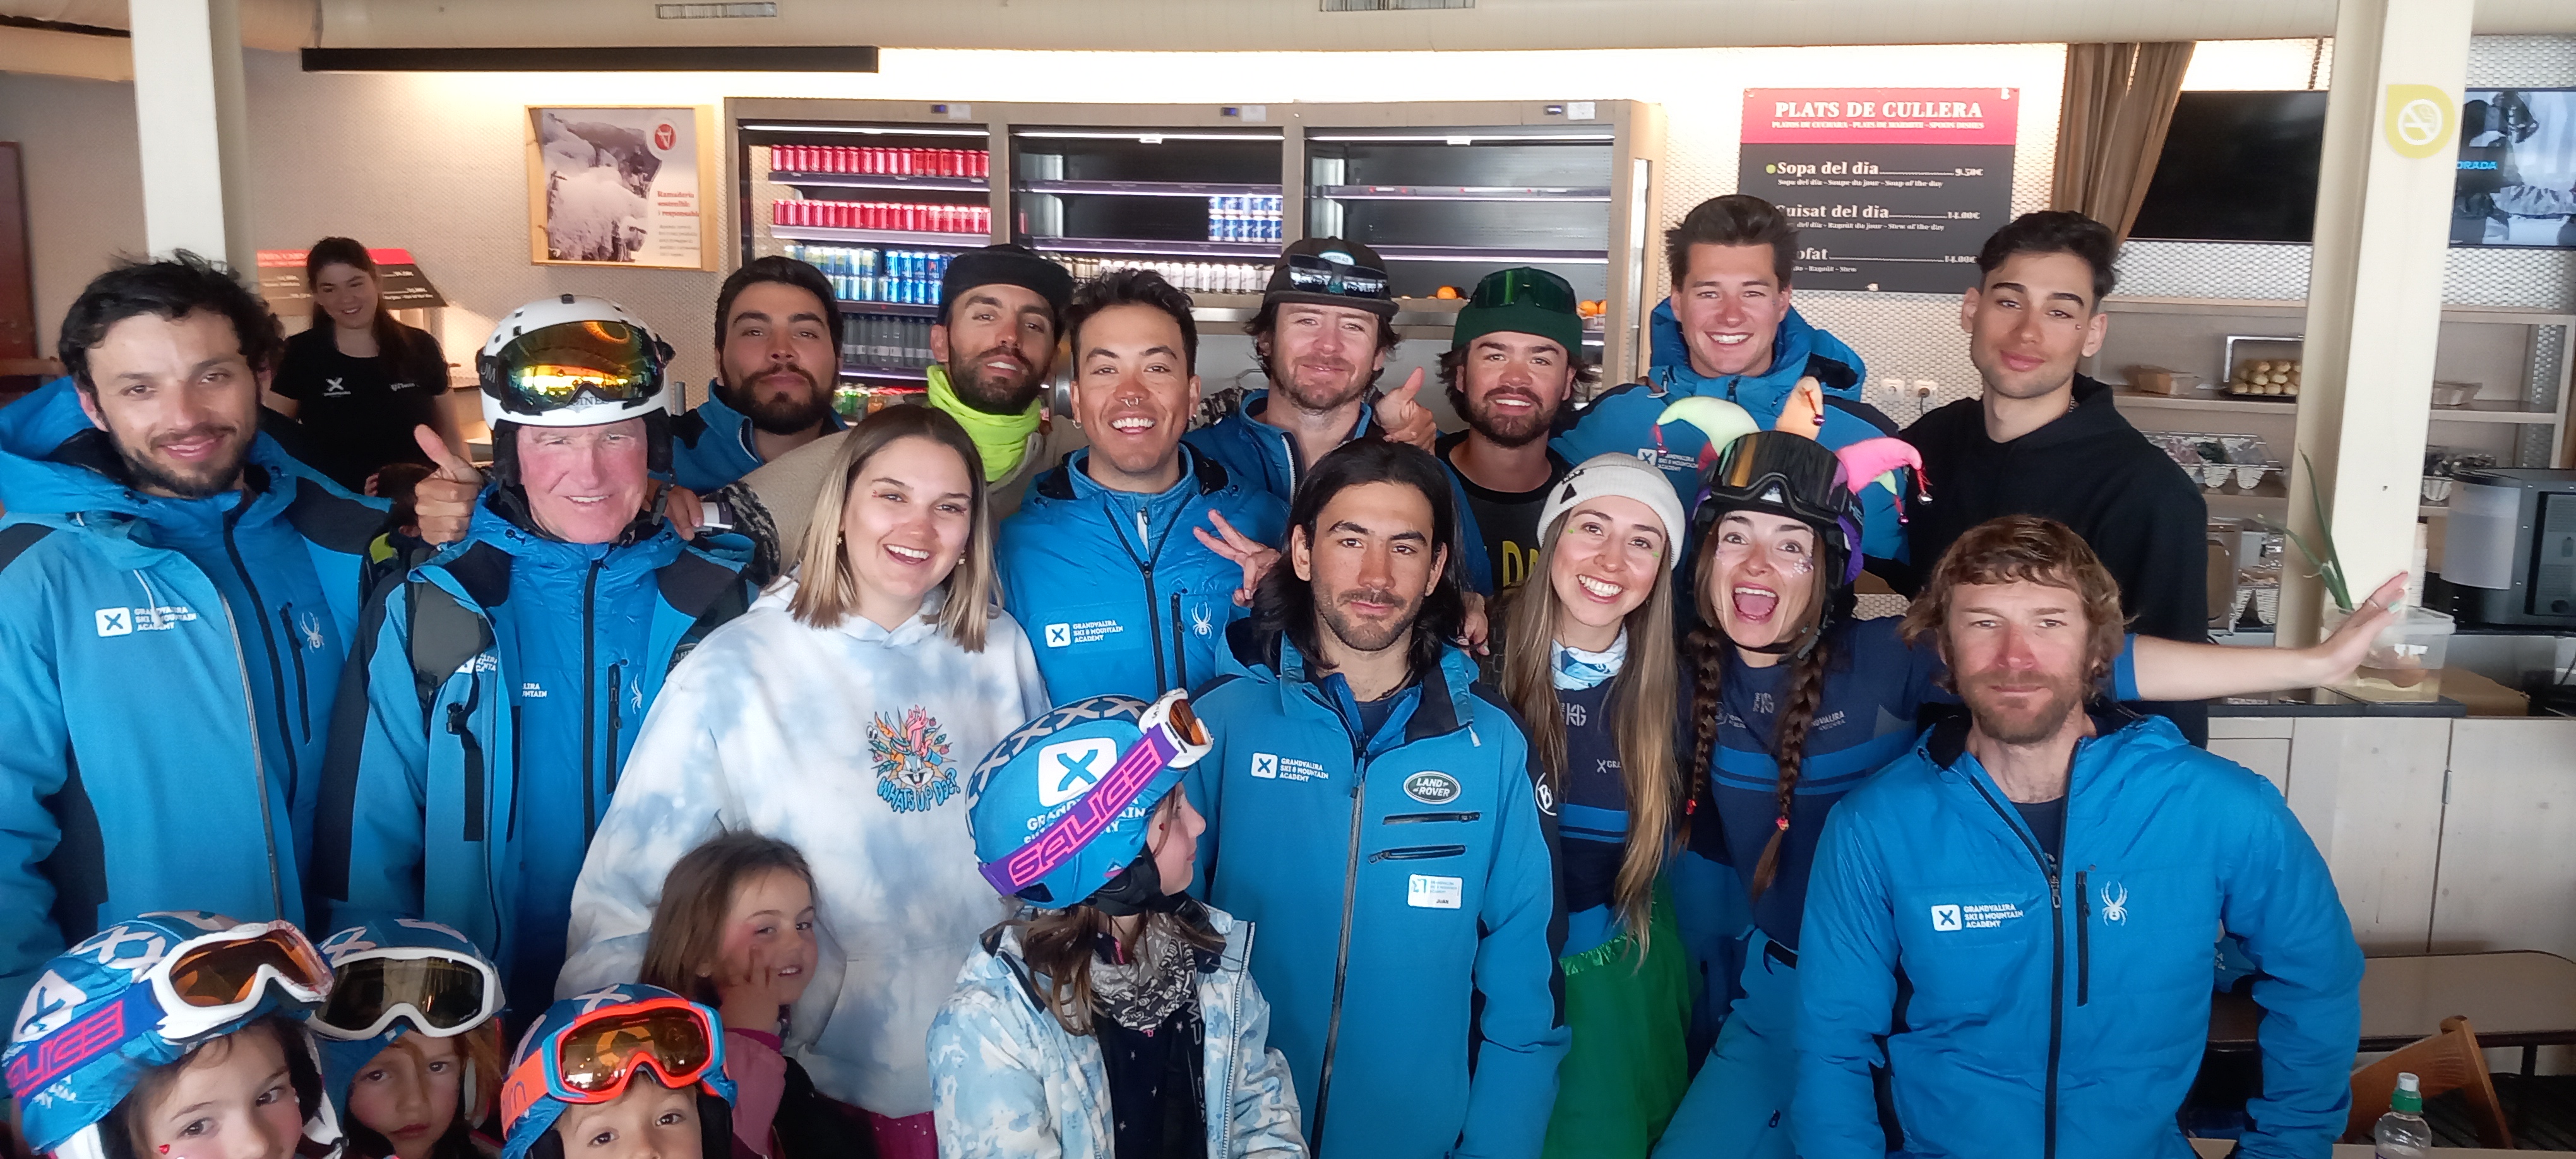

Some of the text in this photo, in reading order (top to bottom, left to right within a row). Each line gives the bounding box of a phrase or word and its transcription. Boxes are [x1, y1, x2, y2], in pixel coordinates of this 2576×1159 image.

[1775, 102, 1983, 118] PLATS DE CULLERA
[1777, 162, 1816, 177] Sopa
[1821, 161, 1847, 174] del
[1831, 205, 1857, 218] del
[1280, 758, 1323, 771] GRANDVALIRA
[1279, 773, 1309, 782] ACADEMY
[1297, 767, 1329, 779] MOUNTAIN
[1416, 778, 1443, 787] LAND
[1418, 787, 1450, 797] ROVER
